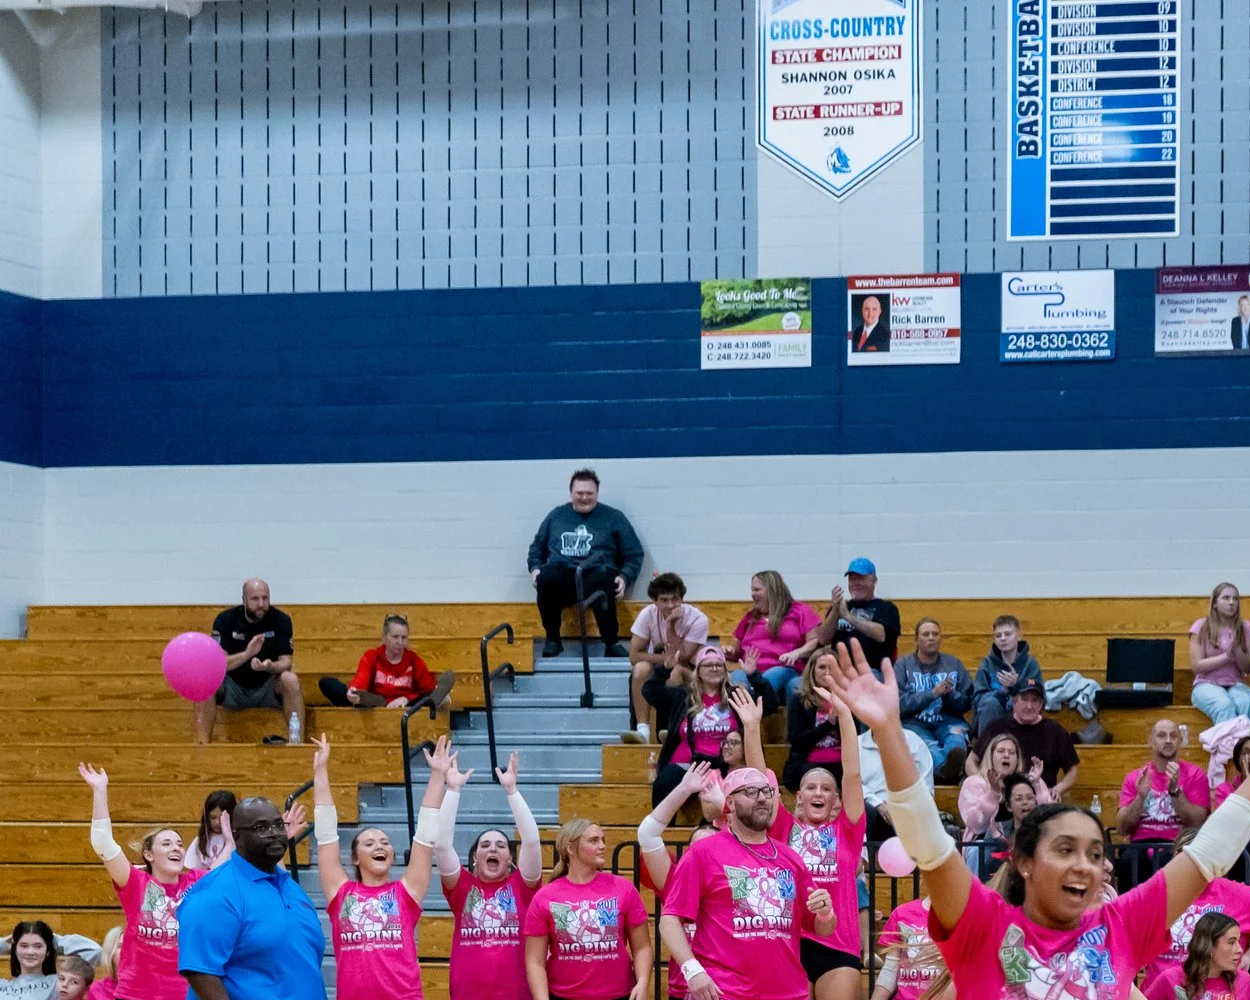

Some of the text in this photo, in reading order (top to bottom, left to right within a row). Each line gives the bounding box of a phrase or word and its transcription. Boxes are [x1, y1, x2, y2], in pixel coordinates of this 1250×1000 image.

[1057, 1, 1170, 19] DIVISION 09
[770, 16, 906, 40] CROSS-COUNTRY
[1057, 20, 1170, 36] DIVISION 10
[1057, 39, 1170, 54] CONFERENCE 10
[775, 45, 899, 64] STATE CHAMPION
[1057, 57, 1170, 73] DIVISION 12
[781, 68, 896, 84] SHANNON OSIKA
[1057, 75, 1170, 92] DISTRICT 12
[823, 85, 853, 95] 2007
[1052, 94, 1173, 110] CONFERENCE 18
[775, 102, 900, 120] STATE RUNNER-UP
[1052, 112, 1173, 128] CONFERENCE 19
[823, 126, 855, 136] 2008
[1052, 131, 1173, 146] CONFERENCE 20
[1052, 149, 1173, 164] CONFERENCE 22
[855, 276, 954, 288] www.thebarrenteam.com
[1162, 274, 1198, 283] DEANNA
[1207, 272, 1239, 282] KELLEY
[715, 289, 741, 303] Looks
[743, 288, 767, 302] Good
[891, 292, 911, 306] kw
[1043, 299, 1107, 319] Plumbing
[891, 314, 945, 324] Rick Barren
[1007, 332, 1109, 350] 248-830-0362
[1004, 349, 1111, 359] www.callcartersplumbing.com
[733, 915, 764, 931] DIG
[138, 924, 164, 939] DIG
[340, 930, 403, 944] DIG PINK
[460, 926, 520, 938] DIG PINK
[584, 940, 619, 953] PINK
